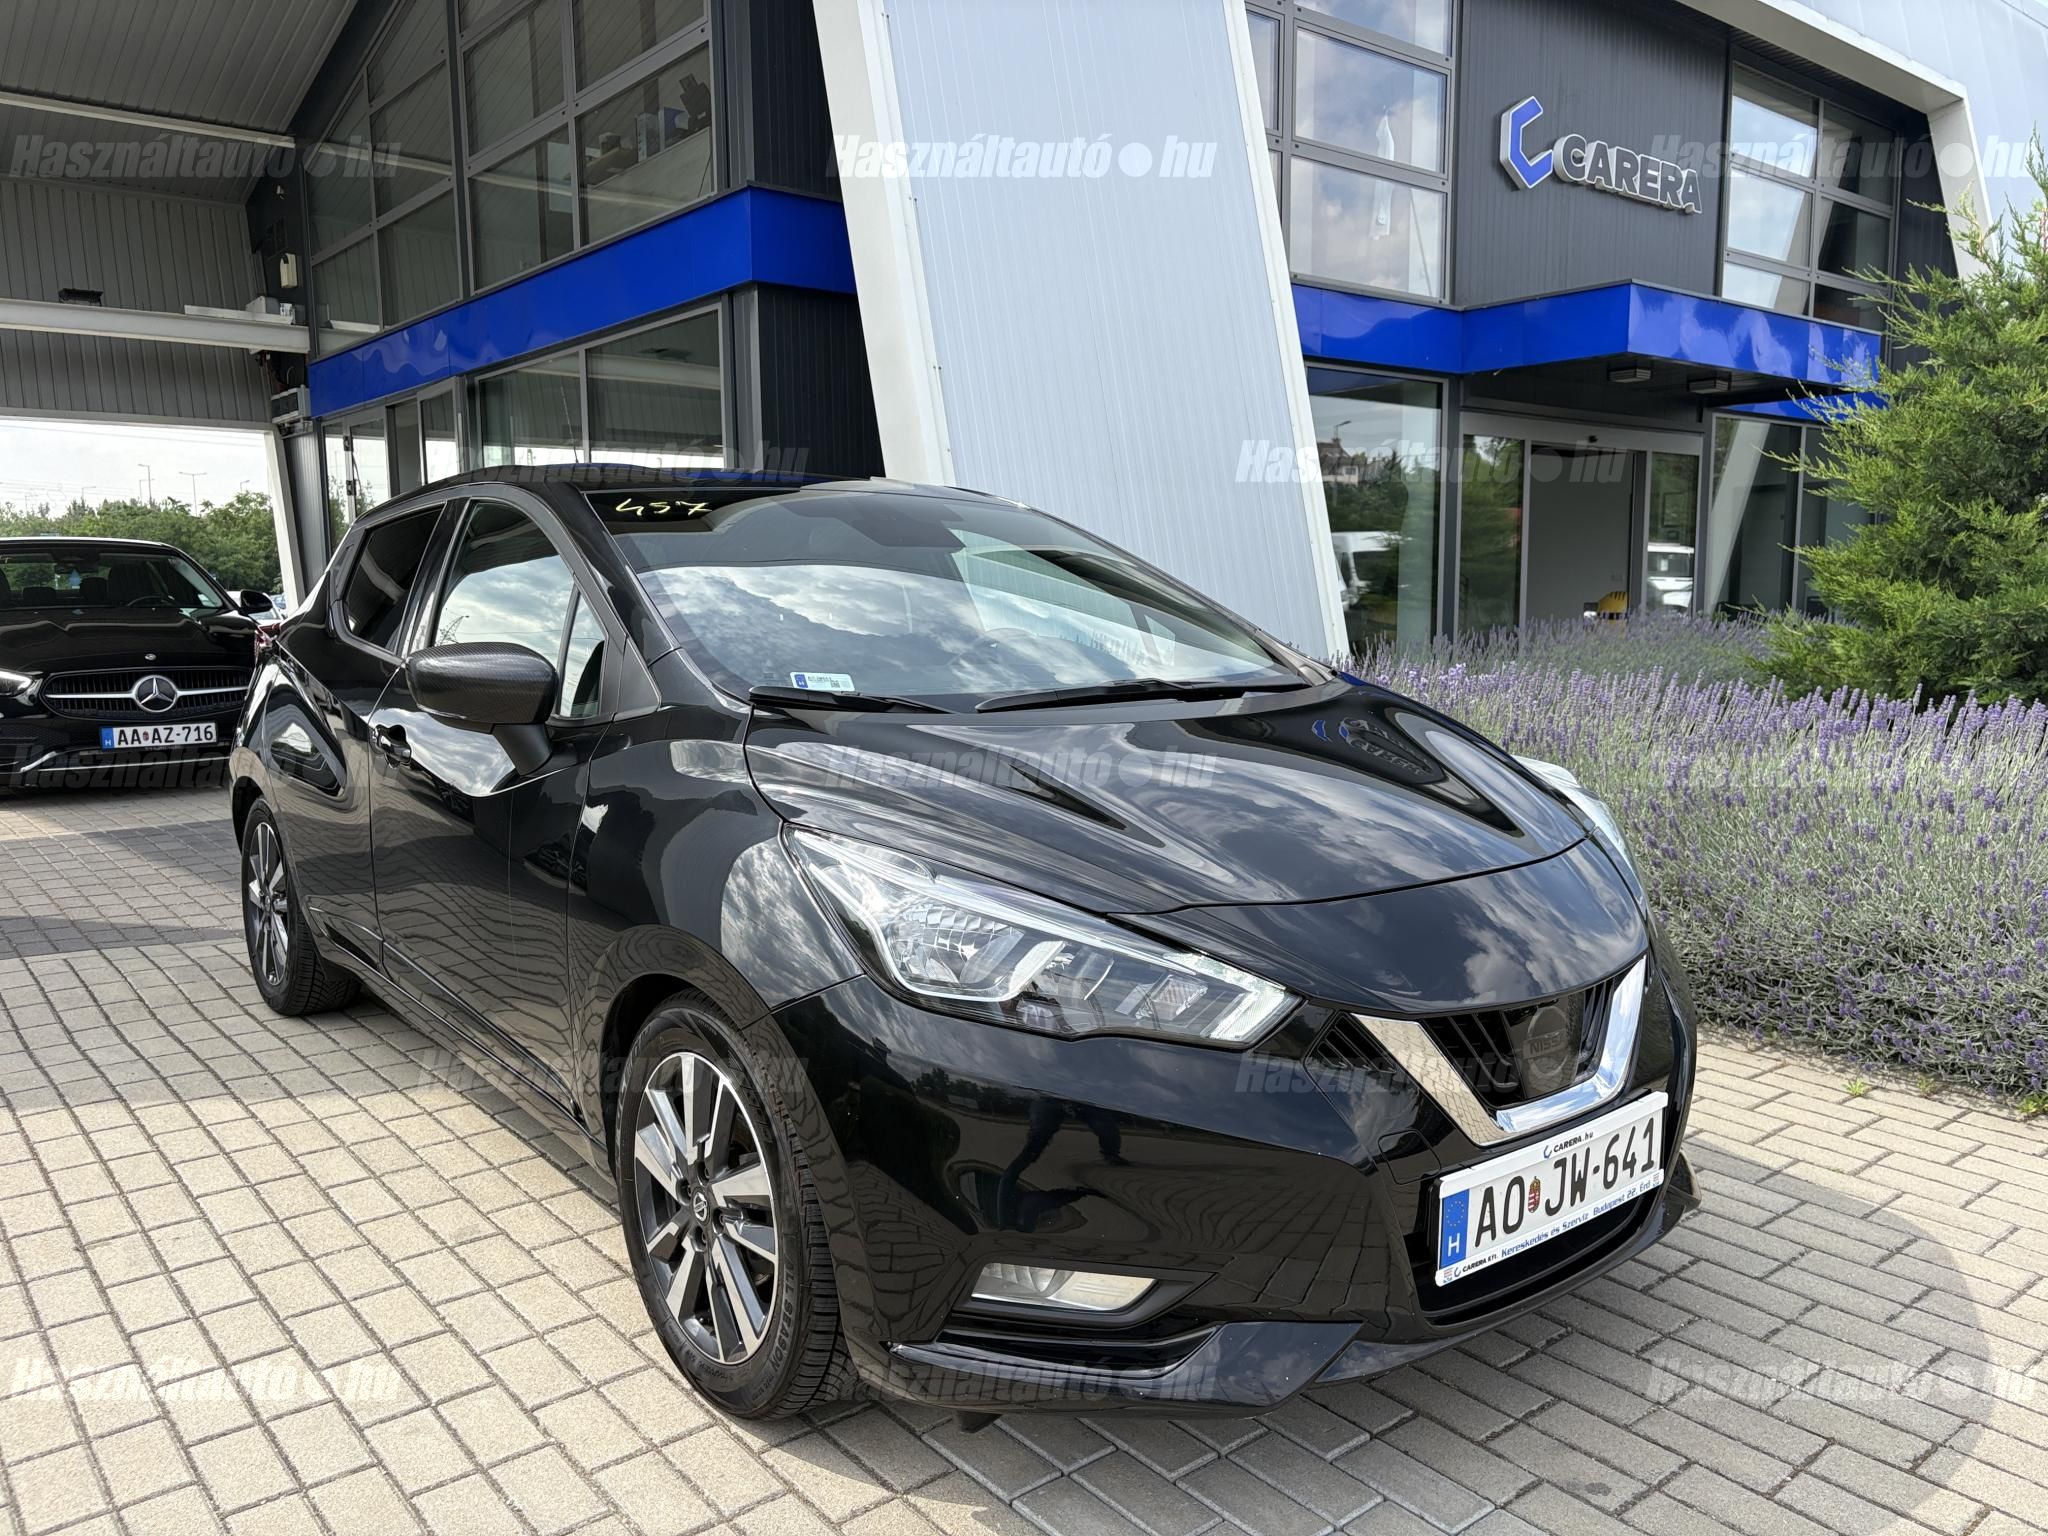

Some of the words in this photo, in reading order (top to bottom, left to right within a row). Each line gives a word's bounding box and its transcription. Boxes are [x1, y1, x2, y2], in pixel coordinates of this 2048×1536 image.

[1554, 133, 1703, 214] CARERA
[1448, 1233, 1460, 1257] H
[1462, 1258, 1487, 1273] CARERA
